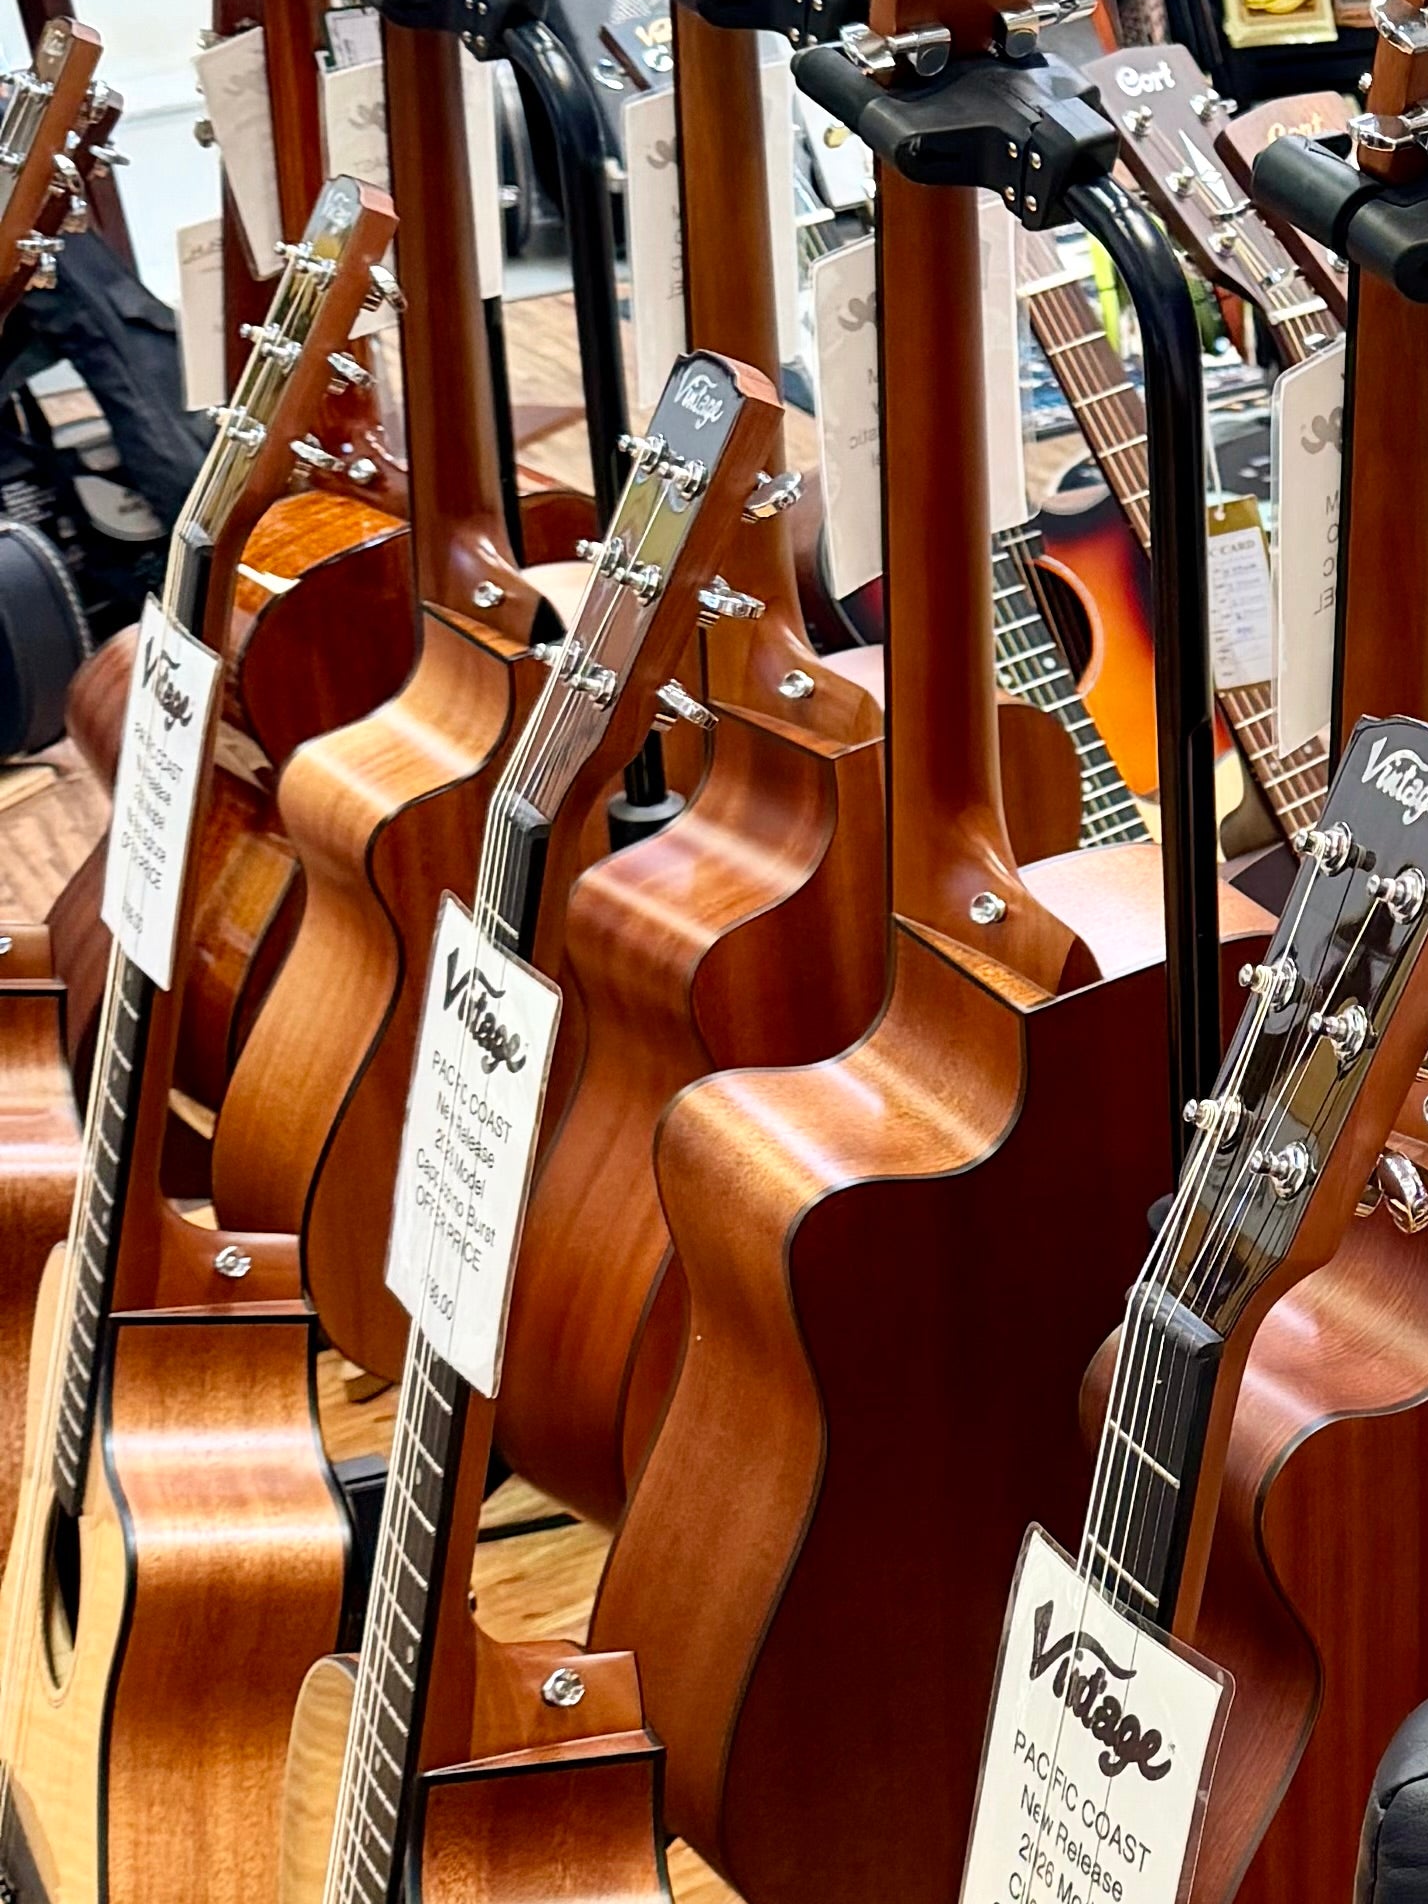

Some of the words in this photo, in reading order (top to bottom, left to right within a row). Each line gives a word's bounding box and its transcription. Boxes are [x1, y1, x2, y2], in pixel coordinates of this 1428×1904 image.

[1115, 59, 1177, 97] Cort
[673, 372, 724, 428] Vintage
[431, 1049, 469, 1106] PACFC
[468, 1093, 513, 1145] COAST
[1029, 1599, 1173, 1782] Vintage
[1012, 1728, 1079, 1813] PACFIC
[1081, 1798, 1152, 1873] COAST
[1020, 1783, 1055, 1837] New
[1054, 1822, 1124, 1904] Release
